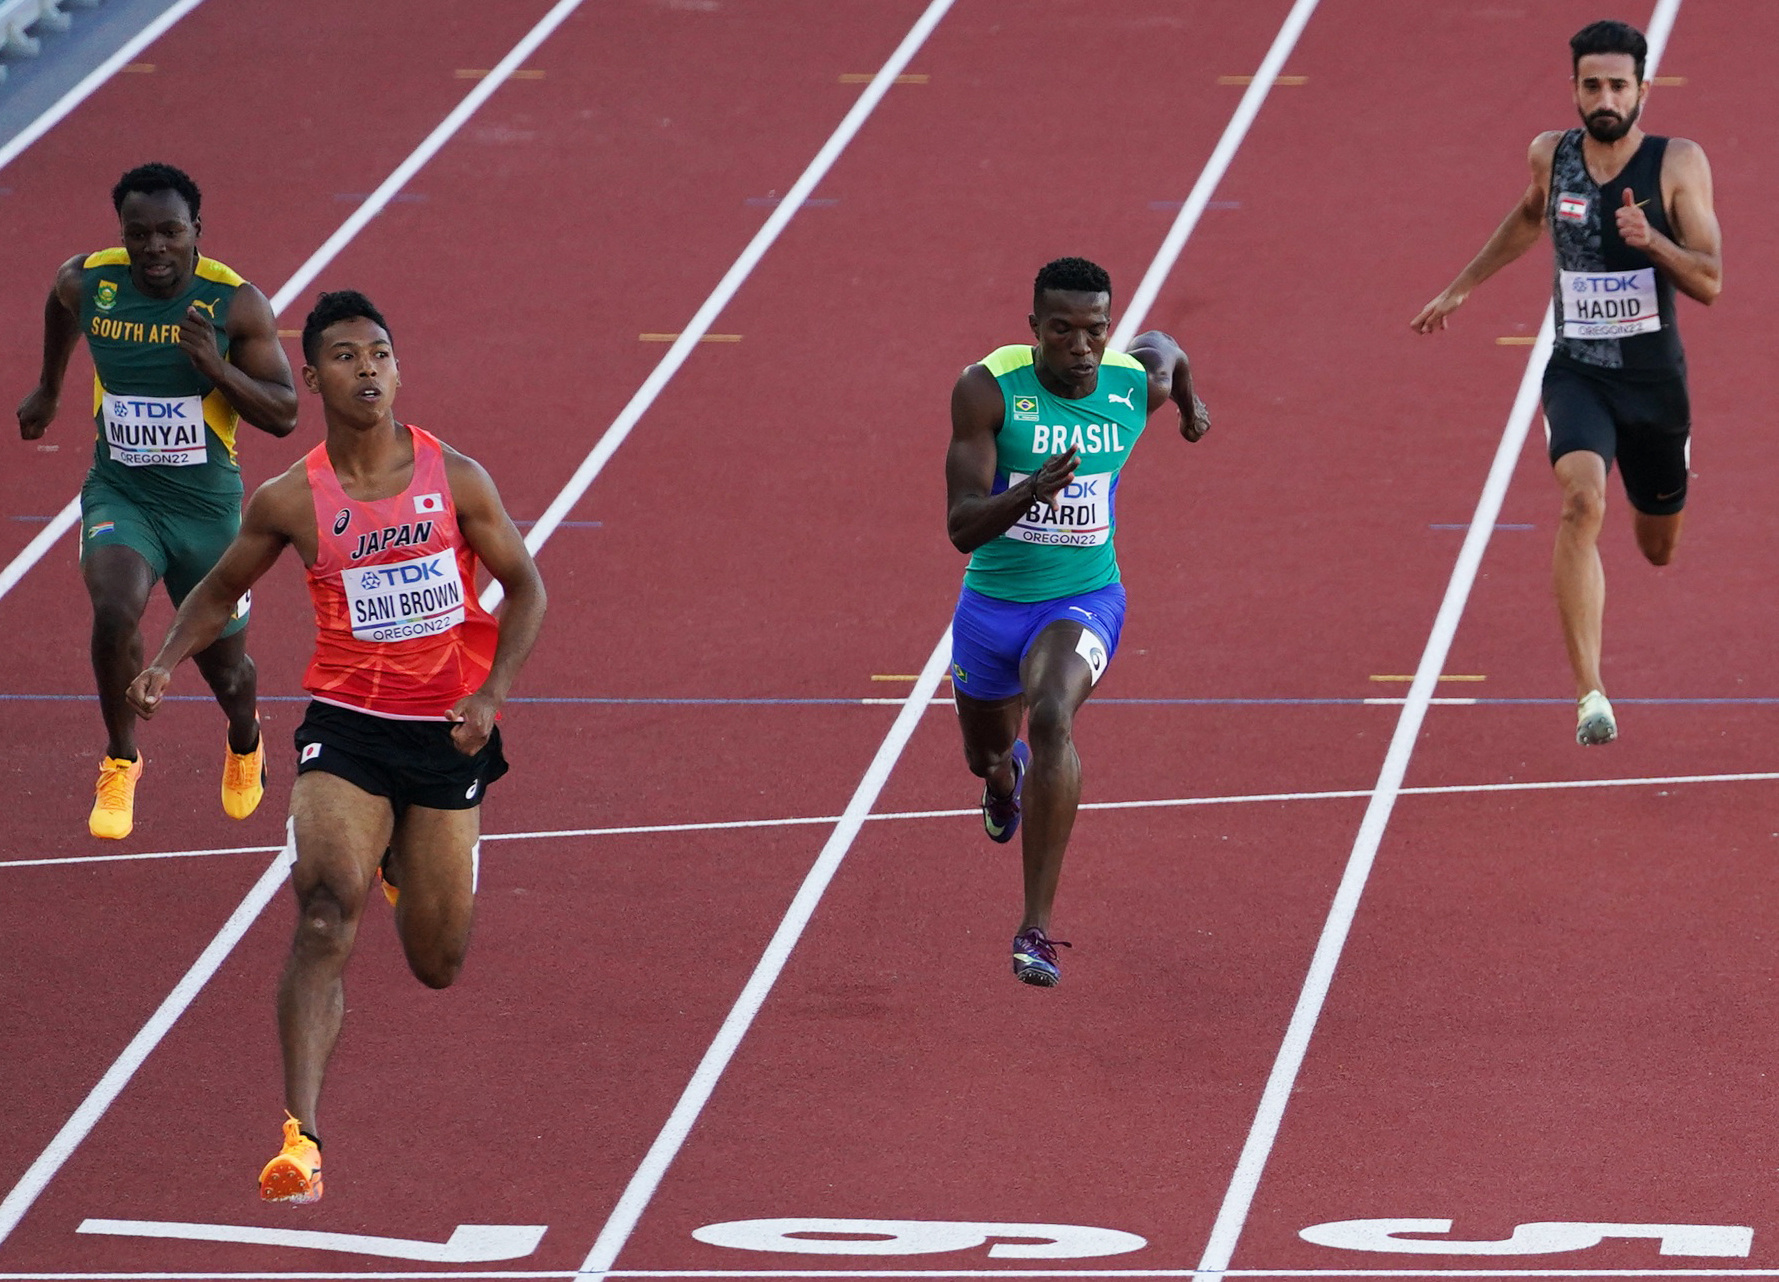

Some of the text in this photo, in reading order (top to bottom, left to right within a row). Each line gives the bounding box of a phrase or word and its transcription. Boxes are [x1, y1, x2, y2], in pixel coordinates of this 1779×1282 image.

[1586, 274, 1640, 293] TDK
[1577, 298, 1641, 319] HADID
[91, 316, 181, 344] SOUTH AFR
[1578, 324, 1644, 335] OREGON22
[127, 401, 187, 419] TDK
[110, 421, 197, 446] MUNYAI
[1031, 423, 1125, 454] BRASIL
[120, 452, 189, 464] OREGON22
[1063, 480, 1098, 499] DK
[1026, 502, 1096, 526] BARDI
[351, 521, 433, 560] JAPAN
[1023, 531, 1096, 545] OREGON22
[378, 558, 444, 587] TDK
[355, 580, 459, 623] SANI BROWN
[373, 616, 451, 641] OREGON22
[75, 1218, 548, 1262] 7
[1298, 1217, 1754, 1257] 5
